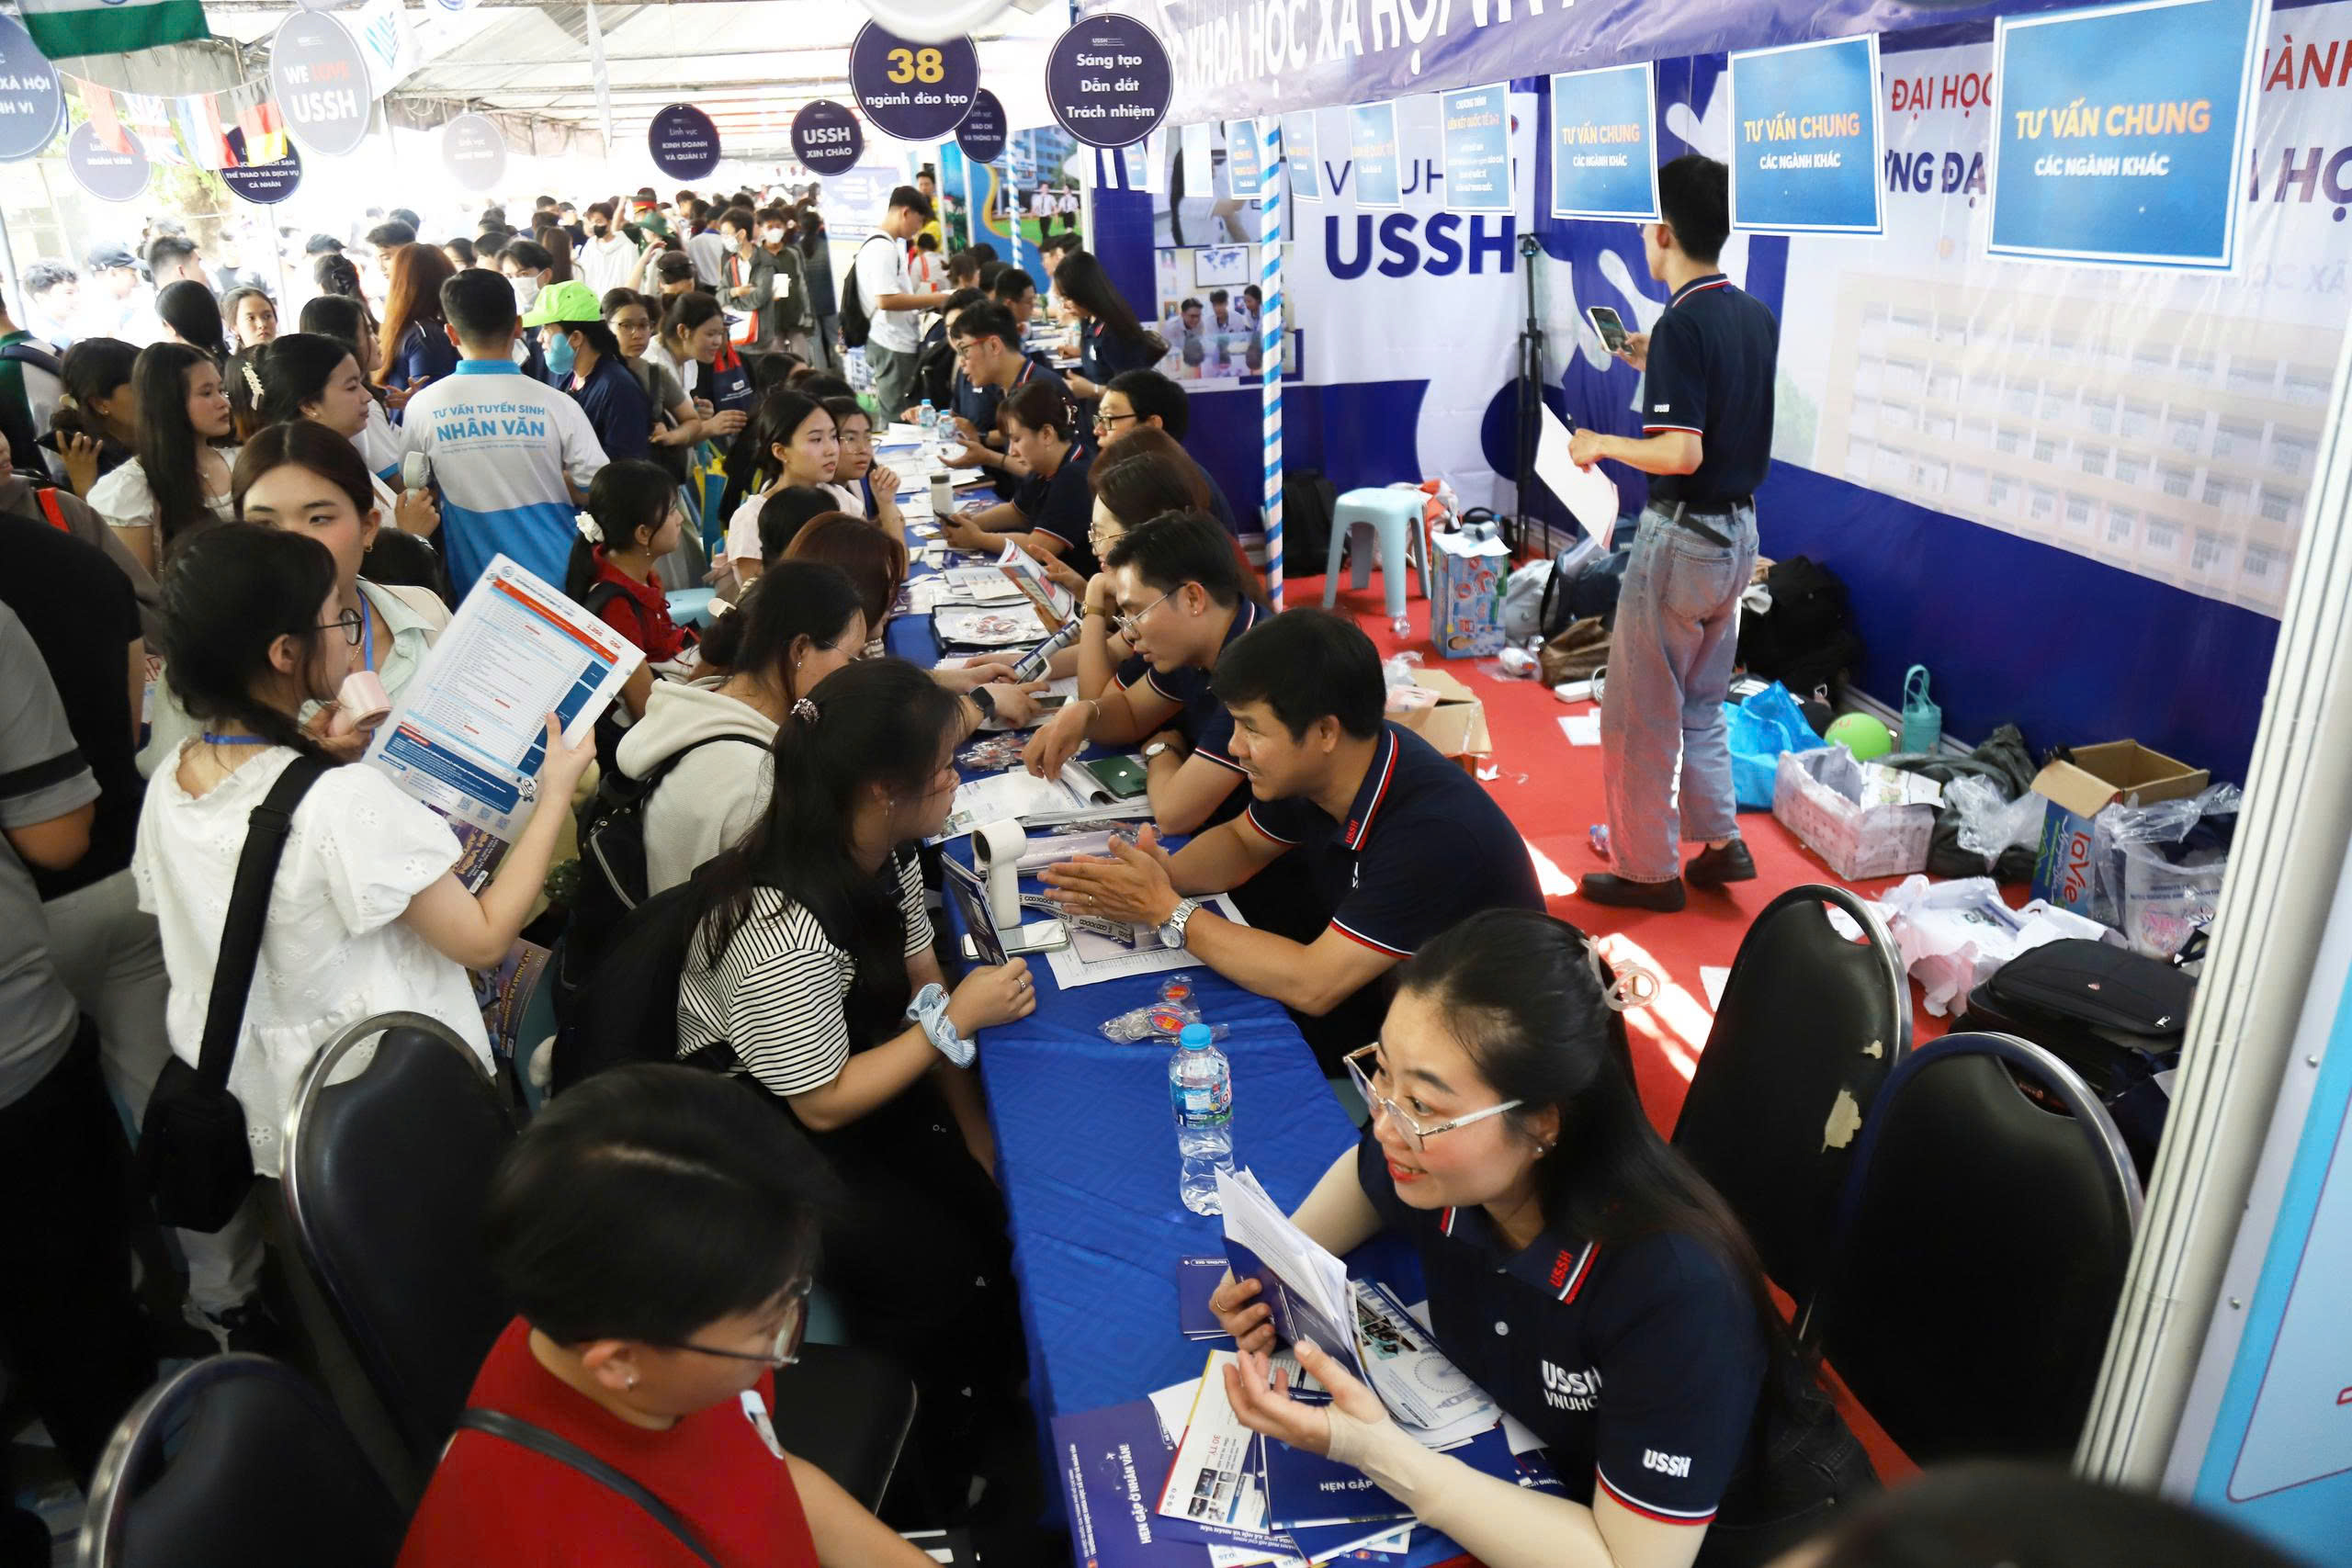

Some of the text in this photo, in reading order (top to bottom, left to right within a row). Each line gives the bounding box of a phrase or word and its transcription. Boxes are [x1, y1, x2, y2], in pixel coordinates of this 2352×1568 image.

[284, 58, 351, 85] WE LOVE
[887, 48, 944, 84] 38
[1076, 53, 1142, 69] Sáng tạo
[24, 76, 51, 93] HỘI
[1081, 77, 1140, 92] Dẫn dắt
[18, 102, 35, 114] VI
[291, 89, 359, 123] USSH
[865, 92, 968, 108] ngành đào tạo
[1892, 76, 1933, 120] ĐẠI
[1066, 104, 1155, 119] Trách nhiệm
[2016, 96, 2212, 141] TƯ VẤN CHUNG
[803, 127, 852, 144] USSH
[1562, 118, 1641, 145] TƯ VẤN CHUNG
[1744, 110, 1860, 143] TƯ VẤN CHUNG
[682, 141, 708, 149] DOANH
[806, 147, 853, 159] XIN CHÀO
[1573, 152, 1628, 167] CÁC NGÀNH KHÁC
[1759, 151, 1841, 170] CÁC NGÀNH KHÁC
[2033, 151, 2170, 176] CÁC NGÀNH KHÁC
[272, 170, 288, 178] DỊCH
[1941, 152, 1986, 209] ĐẠ
[1325, 212, 1517, 280] USSH
[433, 401, 545, 419] TƯ VẤN TUYỂN SINH
[436, 416, 545, 441] NHÂN VĂN
[1549, 1249, 1574, 1289] USSH
[1542, 1359, 1602, 1396] USSH
[1115, 1443, 1133, 1466] VĂN!
[1642, 1448, 1692, 1478] USSH
[1121, 1464, 1140, 1494] NHÂN
[1320, 1480, 1374, 1492] HẸN GẶP
[1131, 1501, 1148, 1523] GẶP
[1136, 1521, 1153, 1543] HẸN
